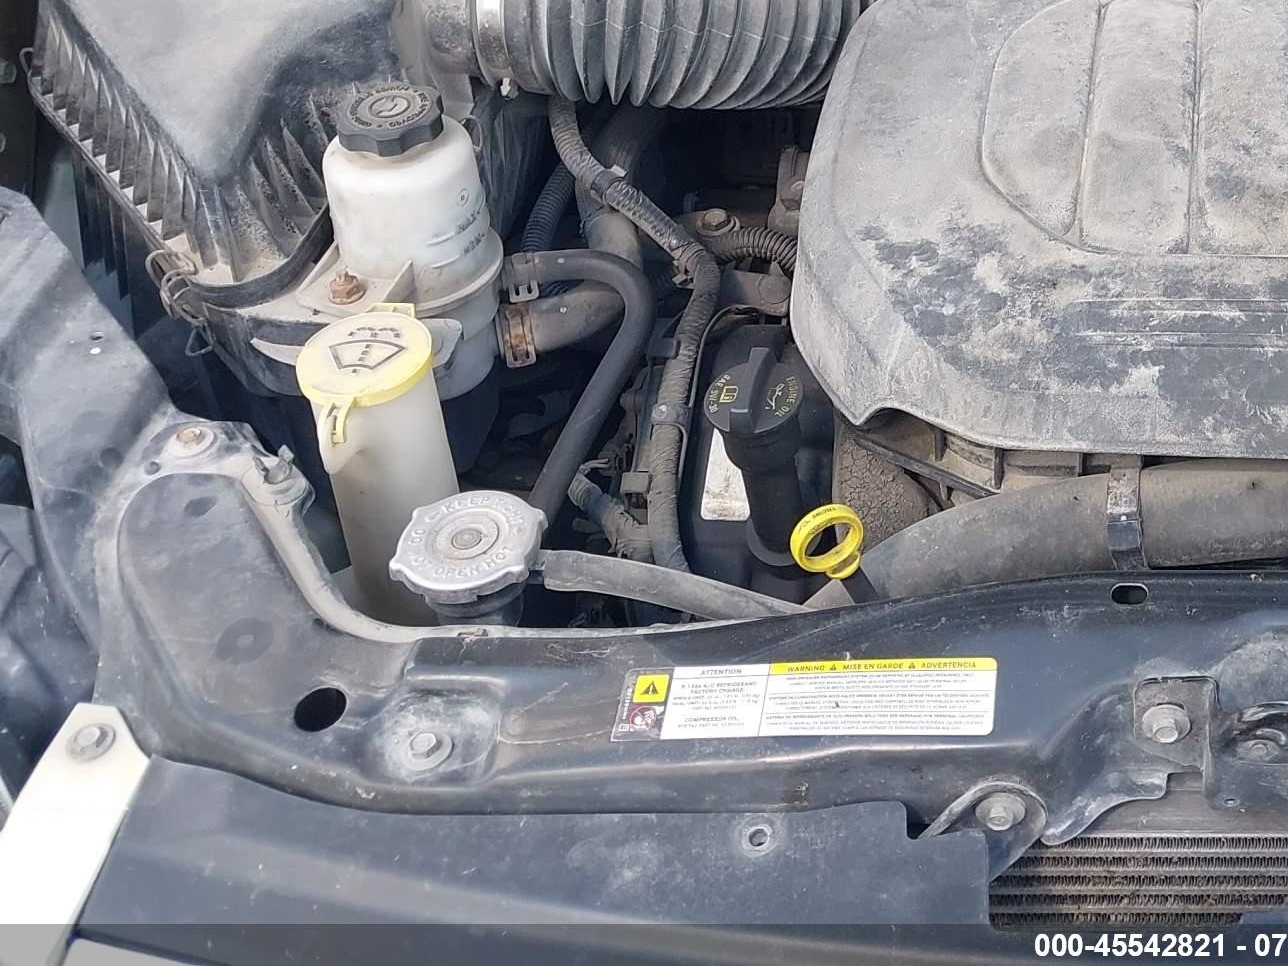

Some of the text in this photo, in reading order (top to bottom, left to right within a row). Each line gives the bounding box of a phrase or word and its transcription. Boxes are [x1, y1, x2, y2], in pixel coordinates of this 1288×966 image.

[701, 668, 742, 676] ATTENTION
[787, 665, 825, 673] WARNING
[843, 663, 862, 671] MISE
[876, 662, 904, 670] GARDE
[921, 661, 977, 669] ADVERTENCIA
